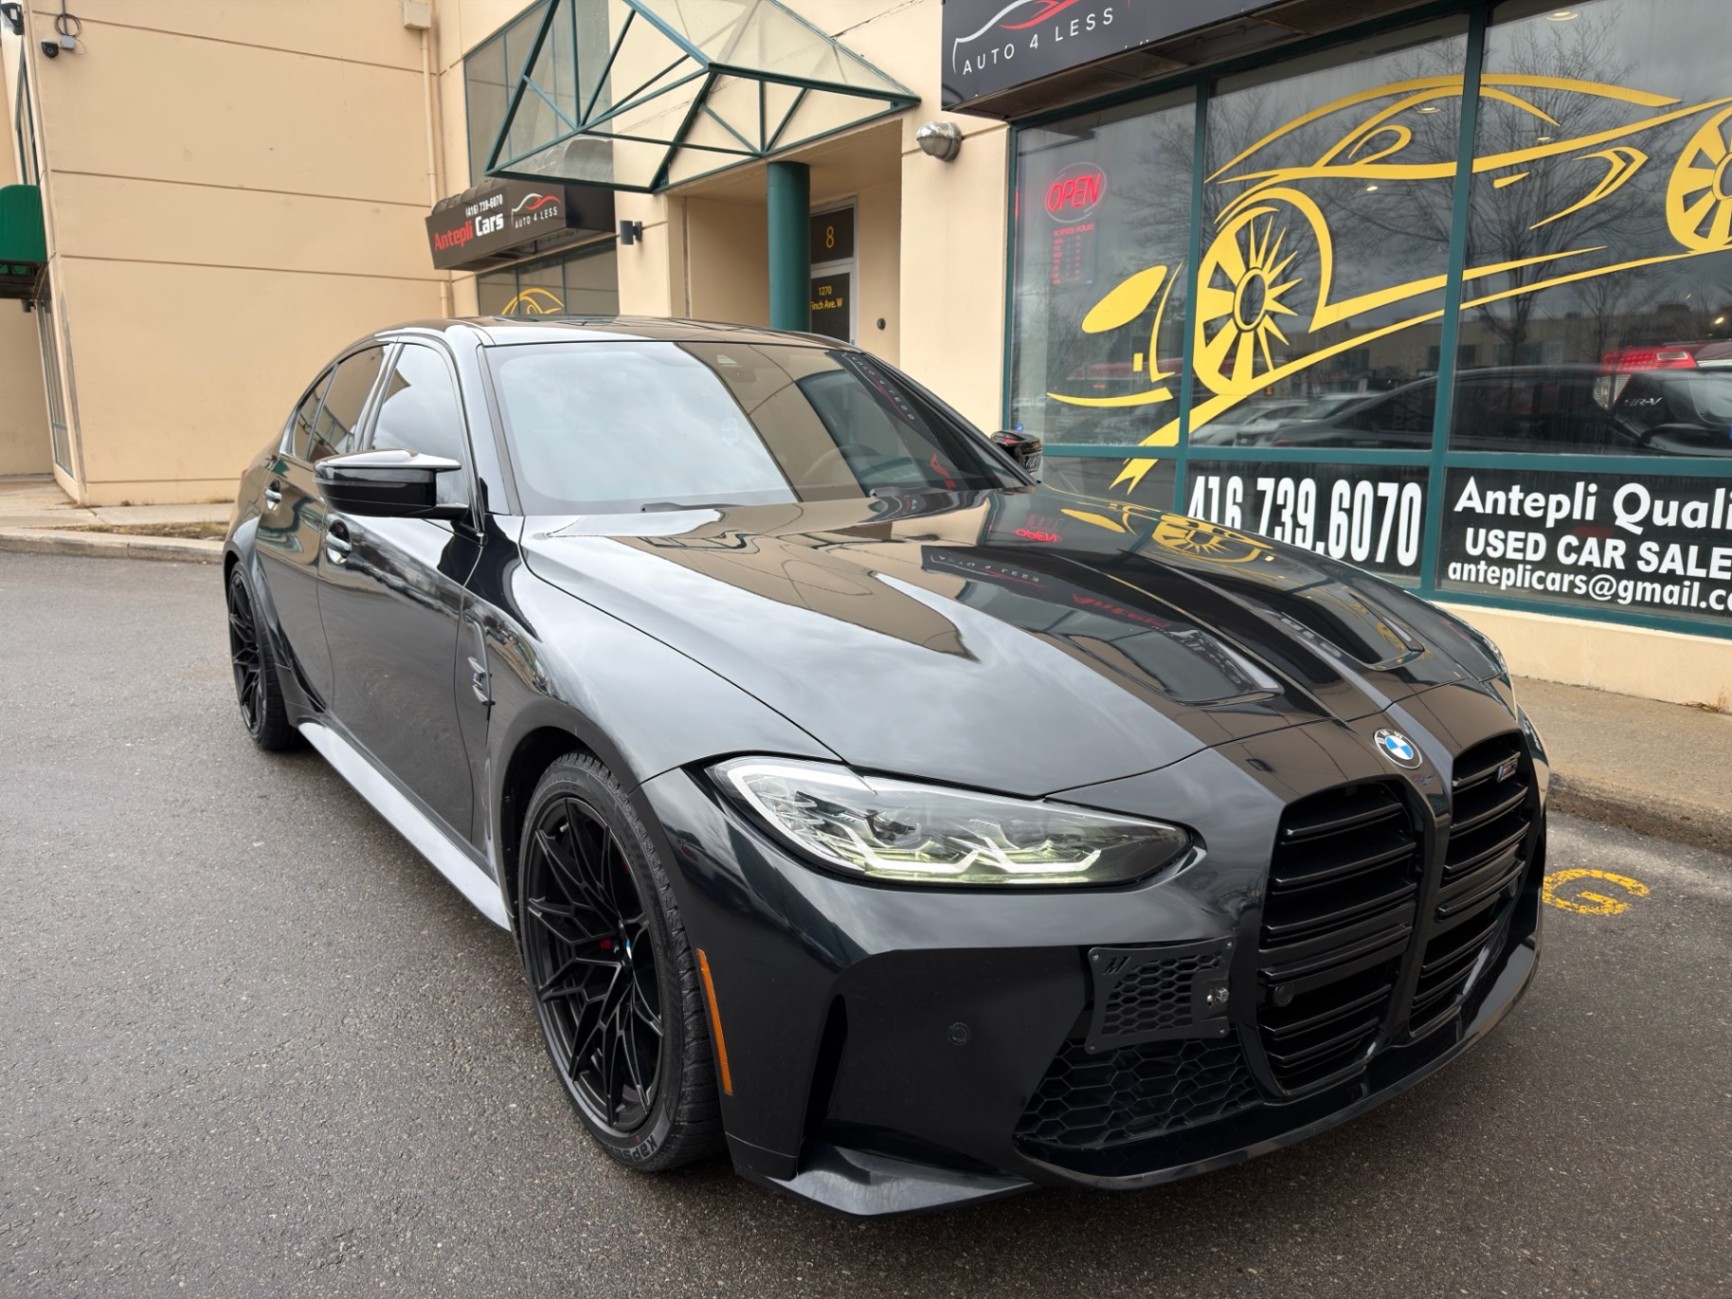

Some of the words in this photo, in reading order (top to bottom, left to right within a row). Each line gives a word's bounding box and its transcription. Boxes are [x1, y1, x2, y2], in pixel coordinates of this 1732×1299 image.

[962, 43, 1015, 75] AUTO
[1029, 34, 1039, 49] 4
[1055, 7, 1114, 42] LESS
[1046, 173, 1101, 212] OPEN
[434, 220, 474, 251] Antepli
[475, 213, 504, 237] Cars
[514, 217, 531, 229] AUTO
[533, 213, 538, 221] 4
[540, 207, 558, 220] LESS
[826, 226, 834, 248] 8
[1453, 475, 1599, 529] Antepli
[1465, 527, 1547, 562] USED
[1556, 535, 1627, 570] CAR
[1541, 868, 1651, 915] G
